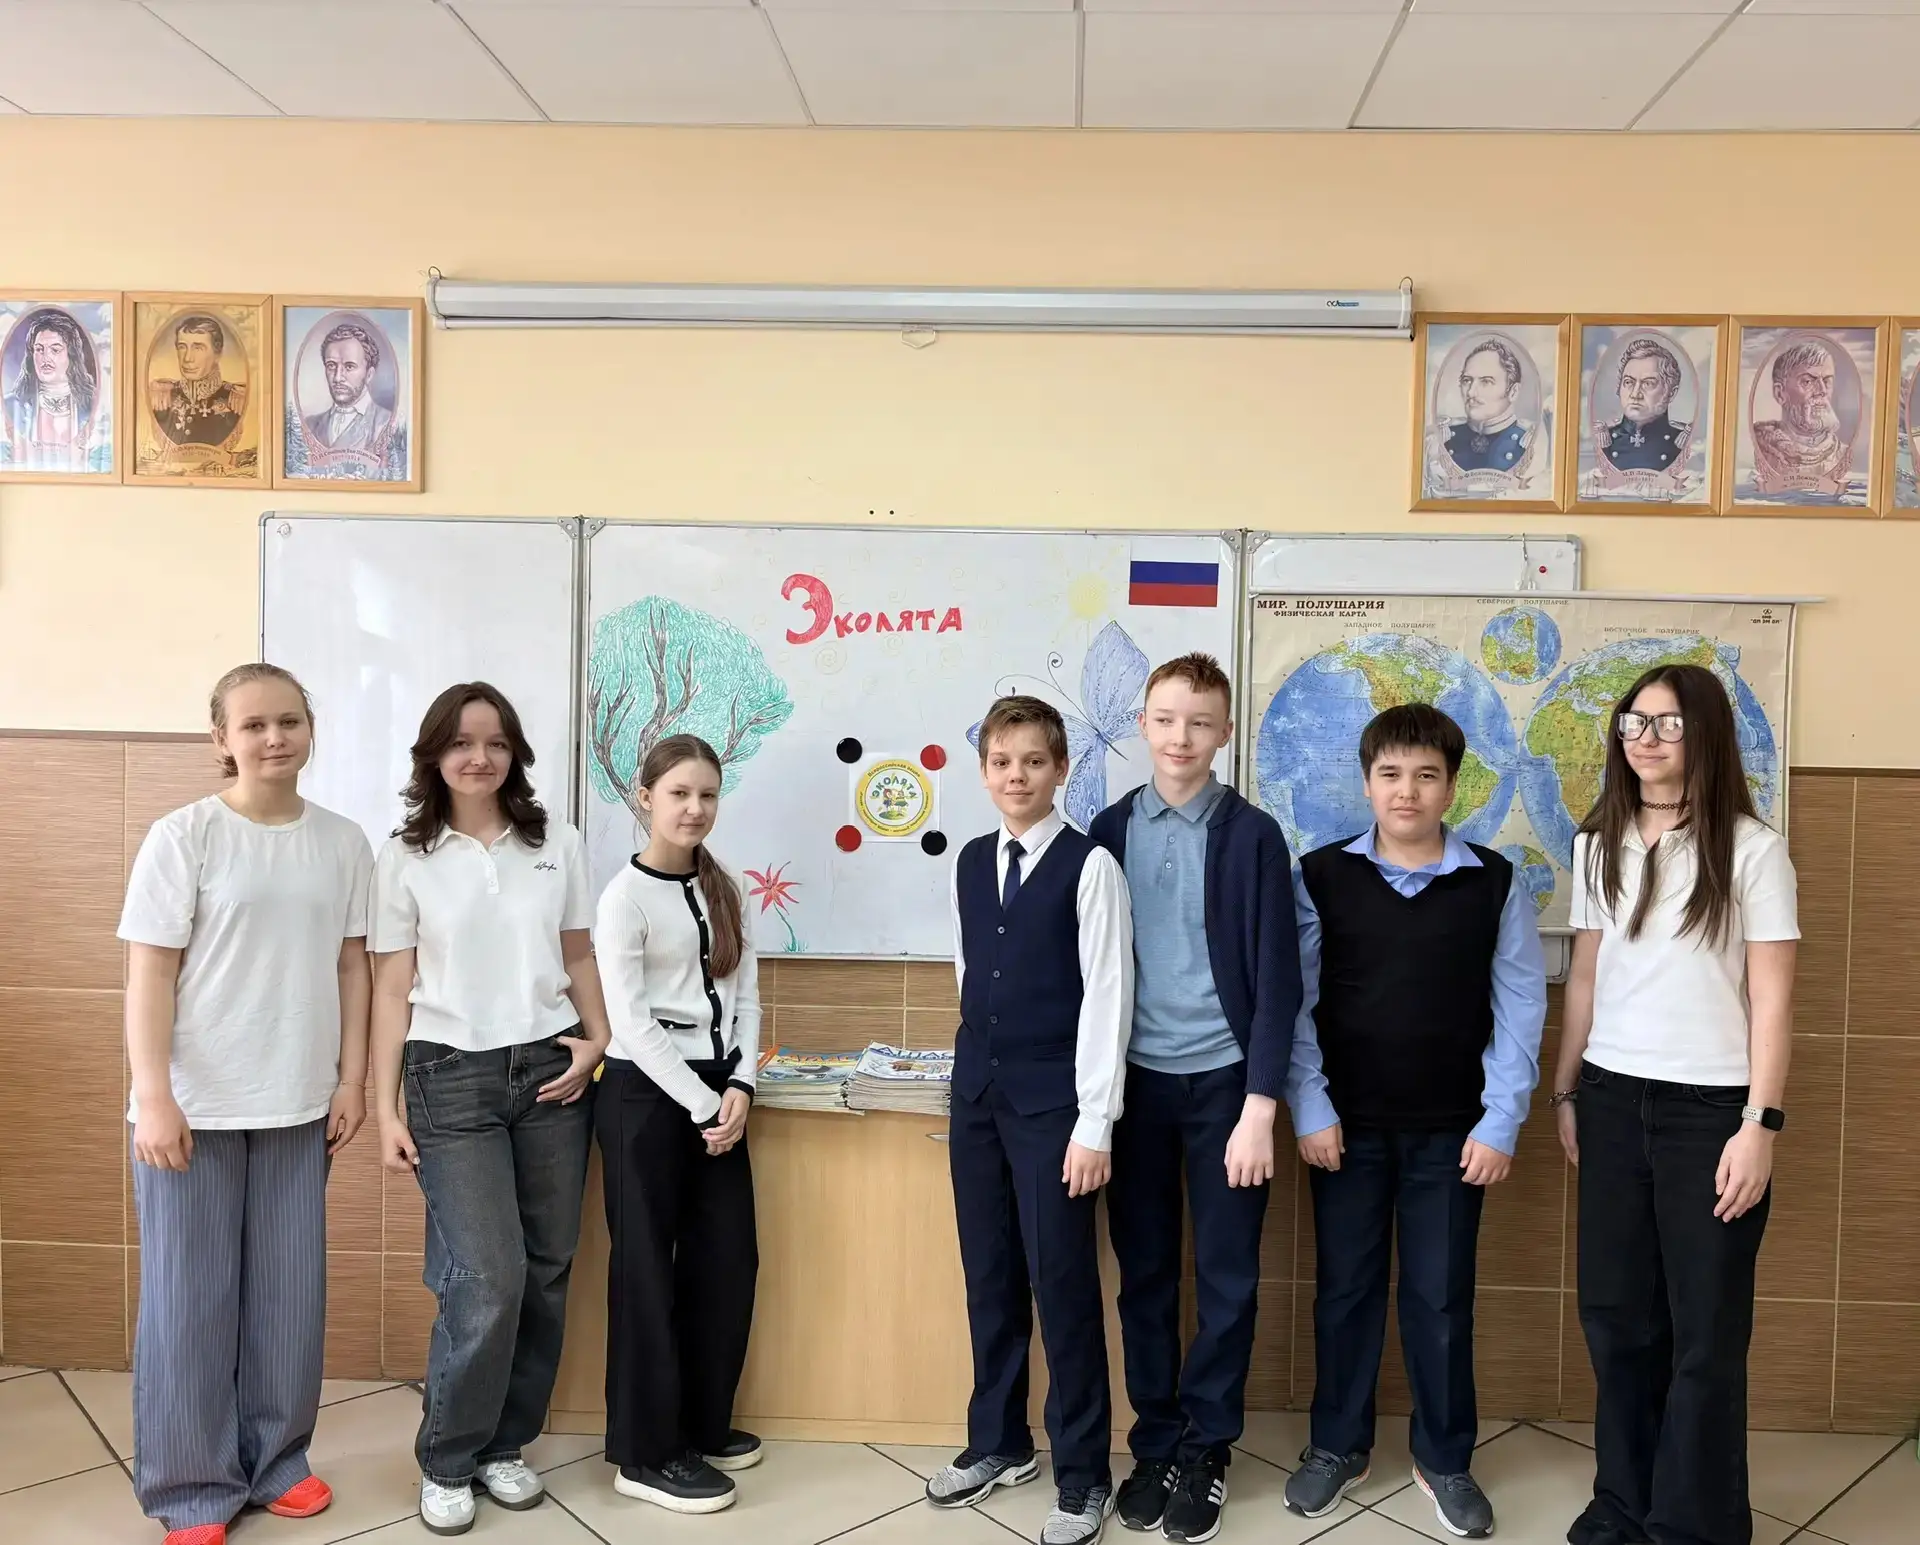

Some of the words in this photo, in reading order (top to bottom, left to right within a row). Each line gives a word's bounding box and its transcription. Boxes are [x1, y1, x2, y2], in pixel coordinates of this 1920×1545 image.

[1257, 600, 1288, 609] МИР.
[1296, 600, 1385, 609] ПОЛУШАРИЯ
[871, 775, 918, 798] ЭКОЛЯТА
